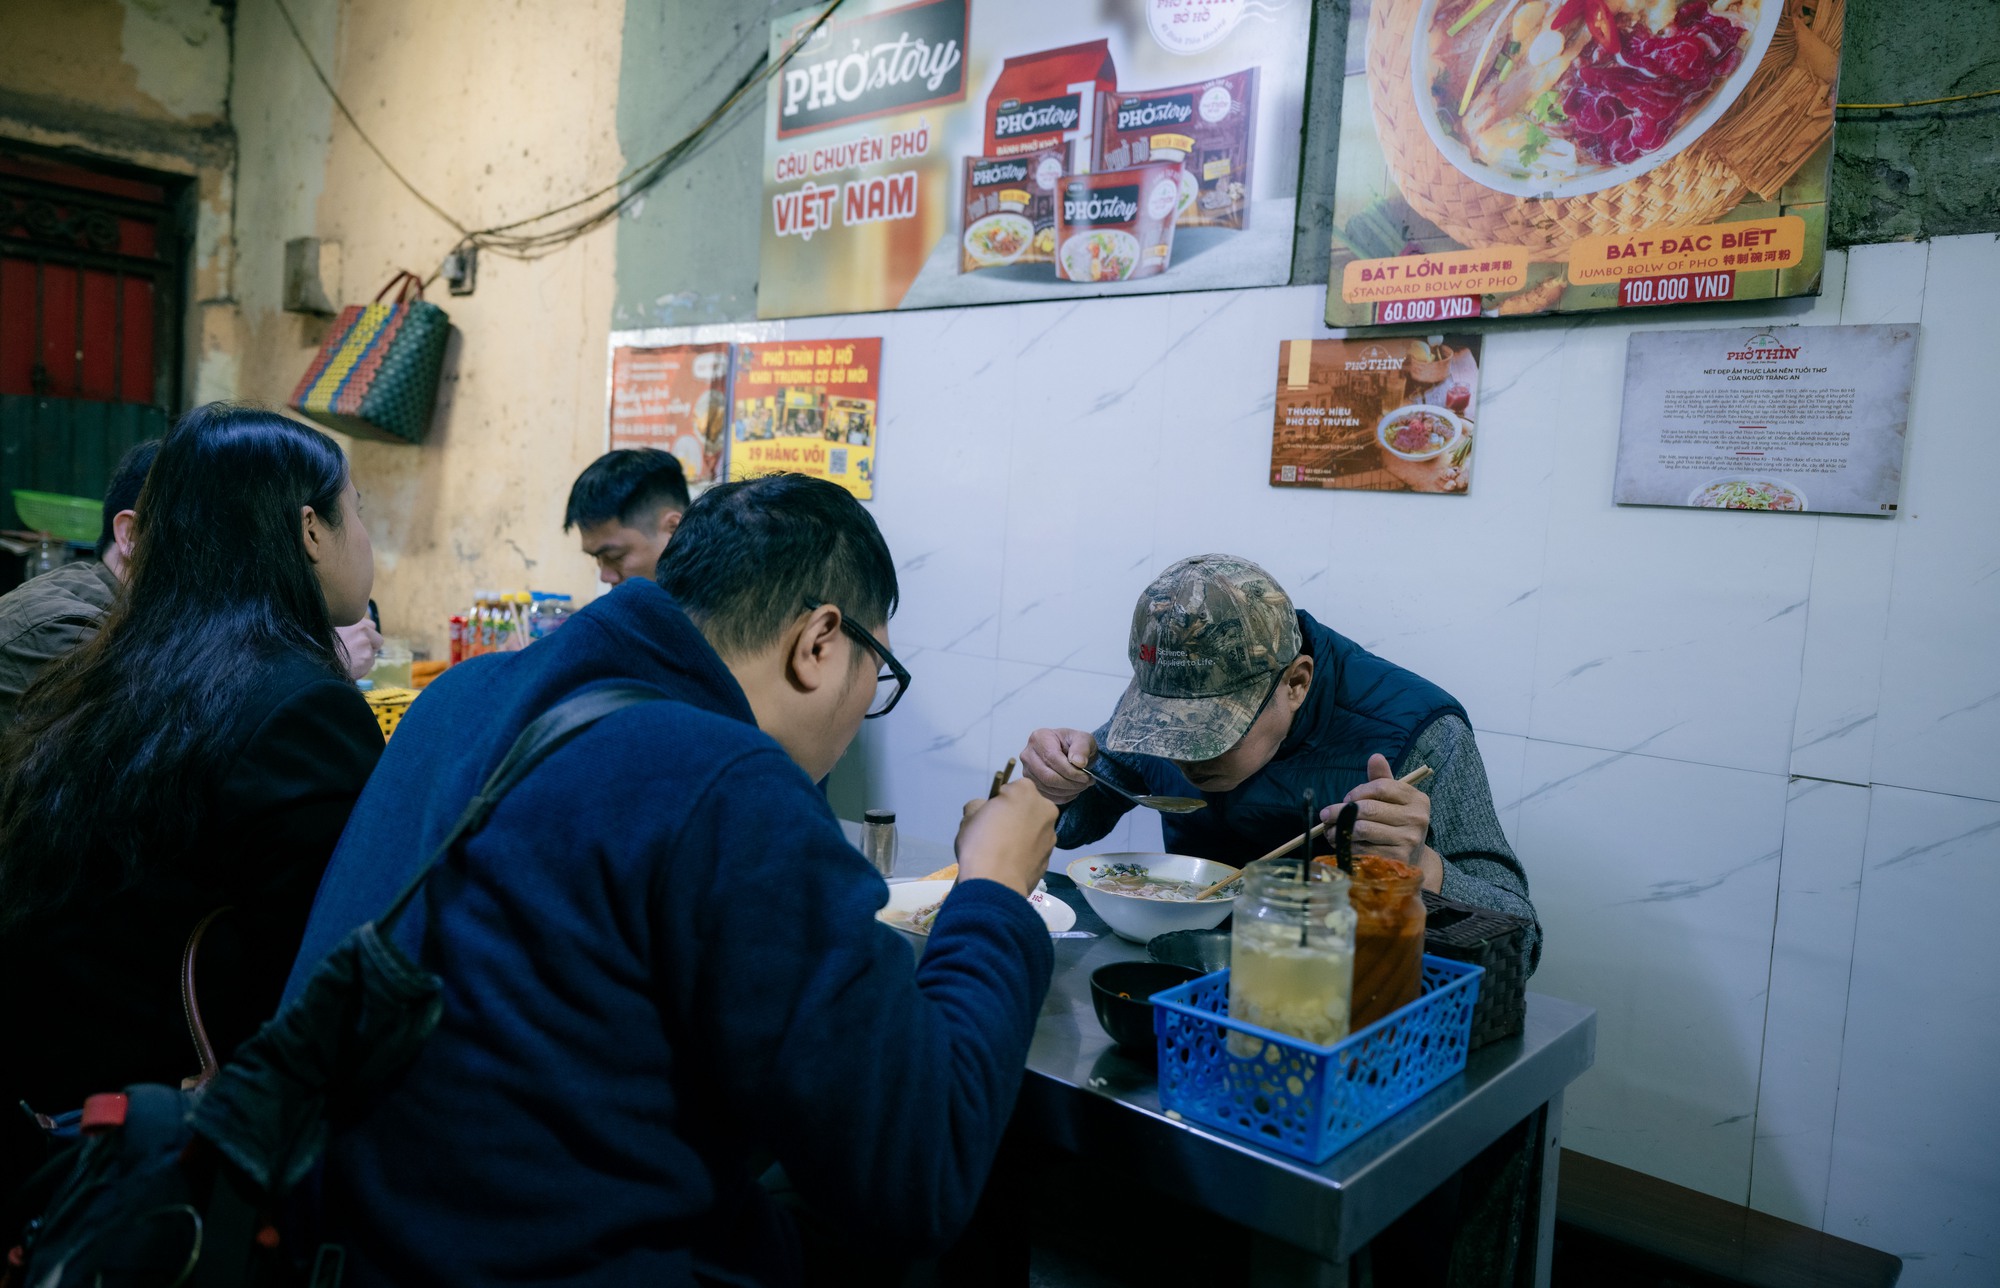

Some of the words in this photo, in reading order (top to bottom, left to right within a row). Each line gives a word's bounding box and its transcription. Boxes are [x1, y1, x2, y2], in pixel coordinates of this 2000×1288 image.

[814, 136, 882, 174] CHUYỆN
[890, 117, 930, 158] PHỞ
[776, 184, 836, 238] VIỆT
[846, 176, 914, 222] NAM
[1606, 236, 1653, 260] BÁT
[1660, 235, 1712, 258] ĐẶC
[1722, 228, 1778, 251] BIỆT
[1361, 262, 1400, 282] BÁT
[1406, 258, 1444, 278] LỚN
[1579, 266, 1622, 278] JUMBO
[1627, 262, 1664, 274] BOLW
[1668, 260, 1684, 270] OF
[1690, 258, 1718, 268] PHO
[1352, 284, 1421, 298] STANDARD
[1425, 280, 1463, 292] BOLW
[1466, 279, 1483, 289] OF
[1488, 275, 1518, 287] PHO
[1624, 277, 1688, 304] 100.000
[1694, 274, 1730, 298] VND
[1384, 300, 1436, 322] 60.000
[1440, 297, 1472, 318] VND
[765, 444, 800, 462] HÀNG
